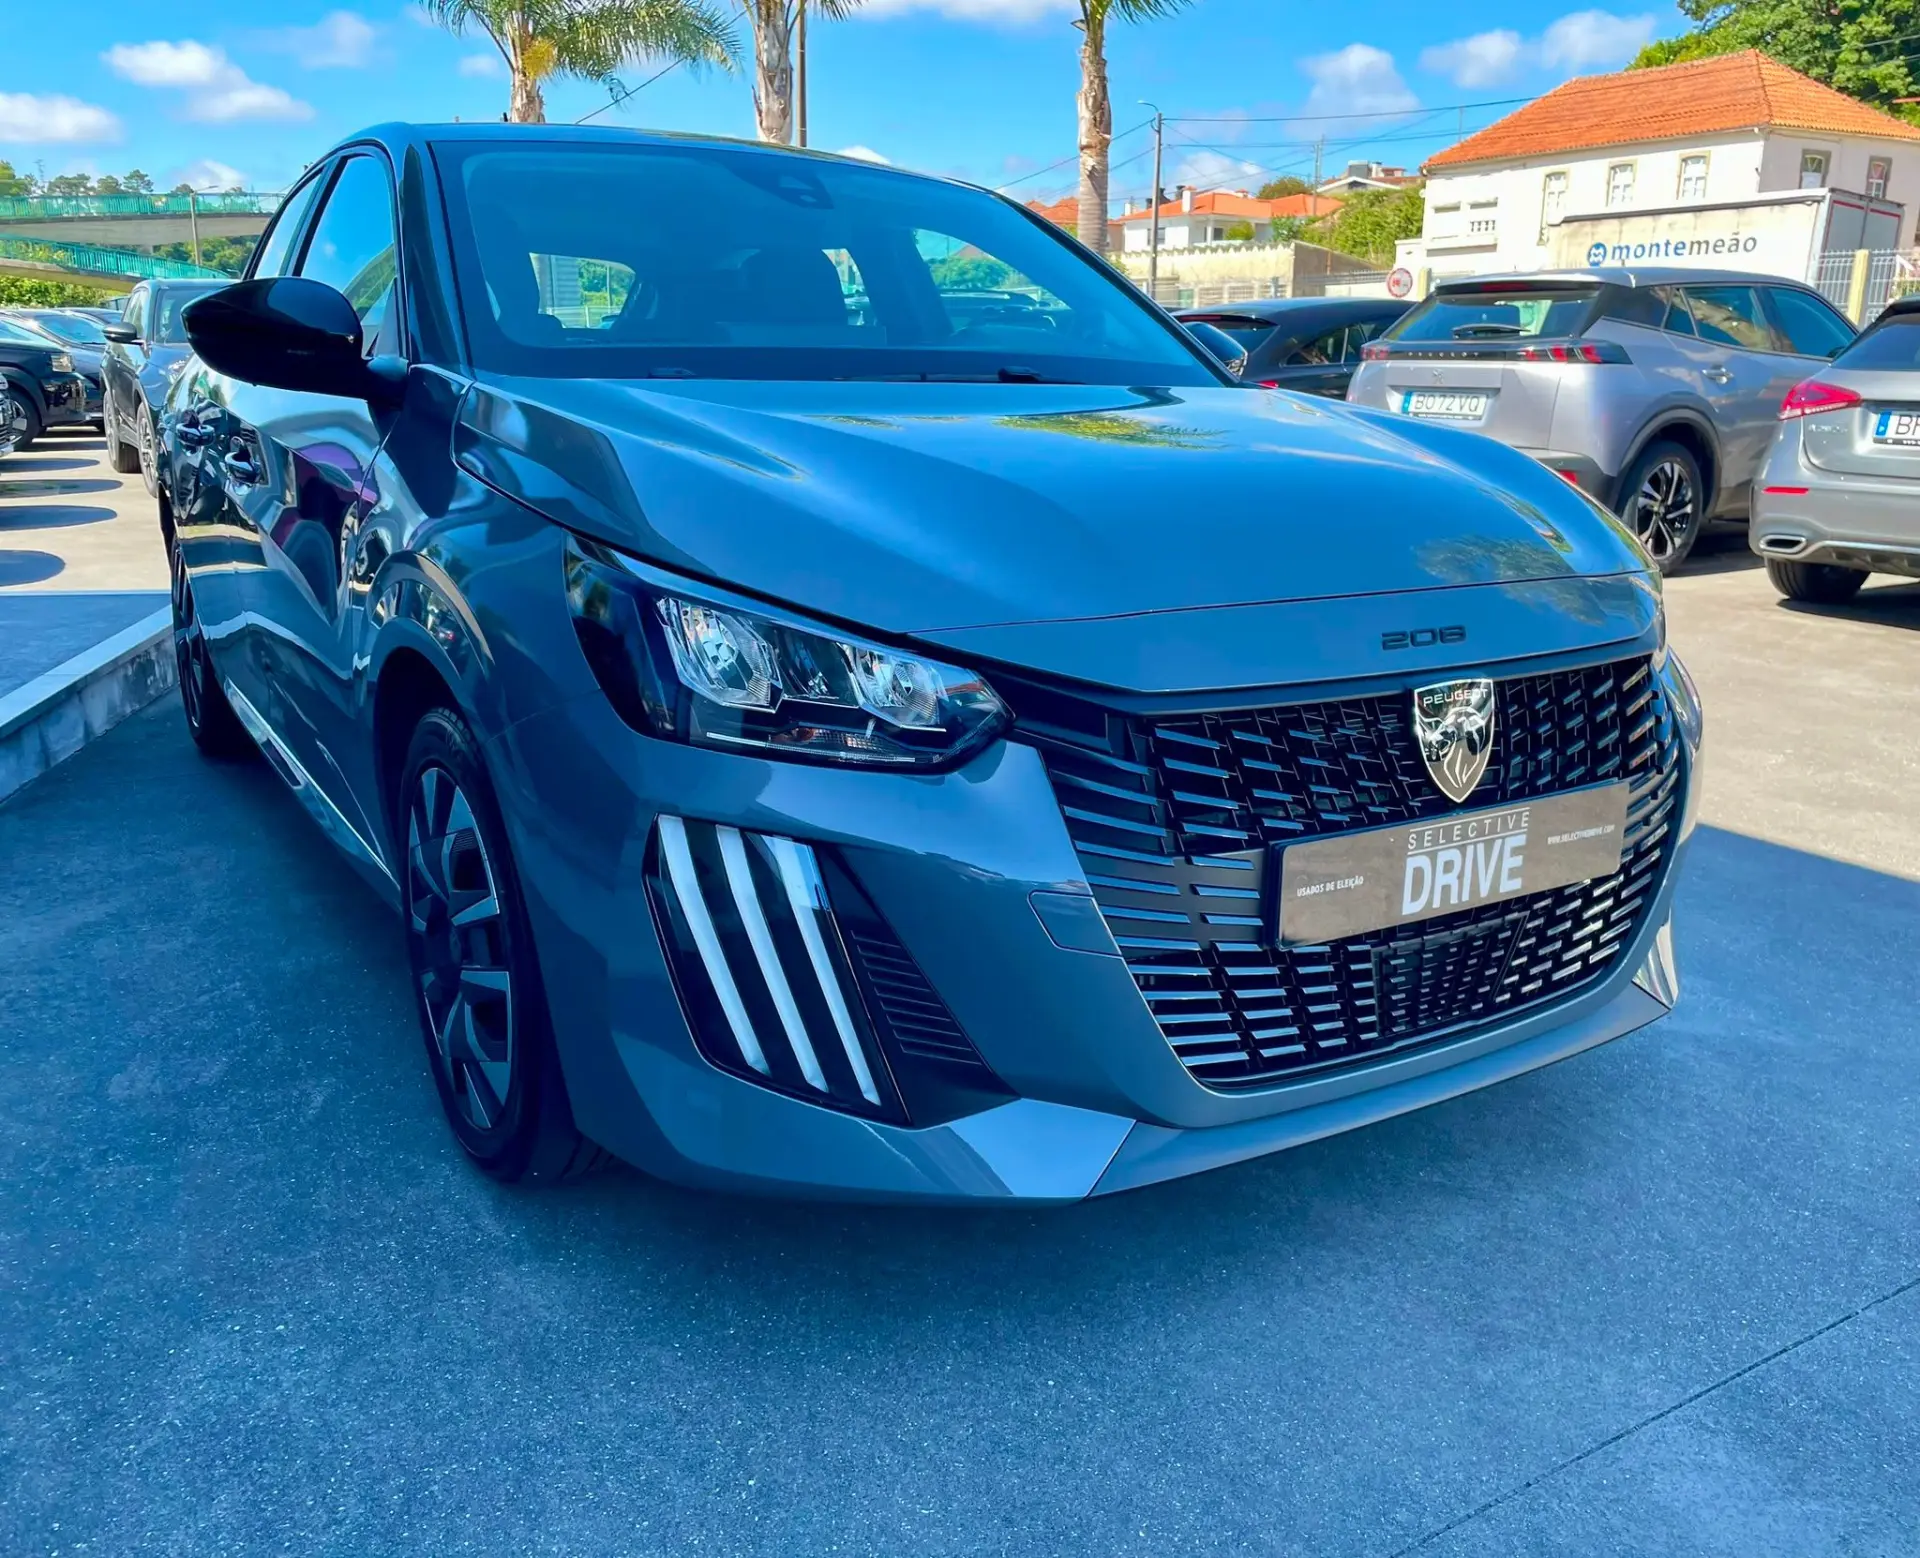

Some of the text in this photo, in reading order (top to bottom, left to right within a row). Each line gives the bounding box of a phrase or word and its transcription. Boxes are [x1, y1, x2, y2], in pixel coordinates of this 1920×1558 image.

[1611, 232, 1757, 260] montemeão
[1423, 688, 1488, 706] PEUGEOT
[1407, 811, 1530, 850] SELECTIVE
[1297, 875, 1364, 897] USADOS DE ELEIÇÃO
[1402, 834, 1526, 915] DRIVE
